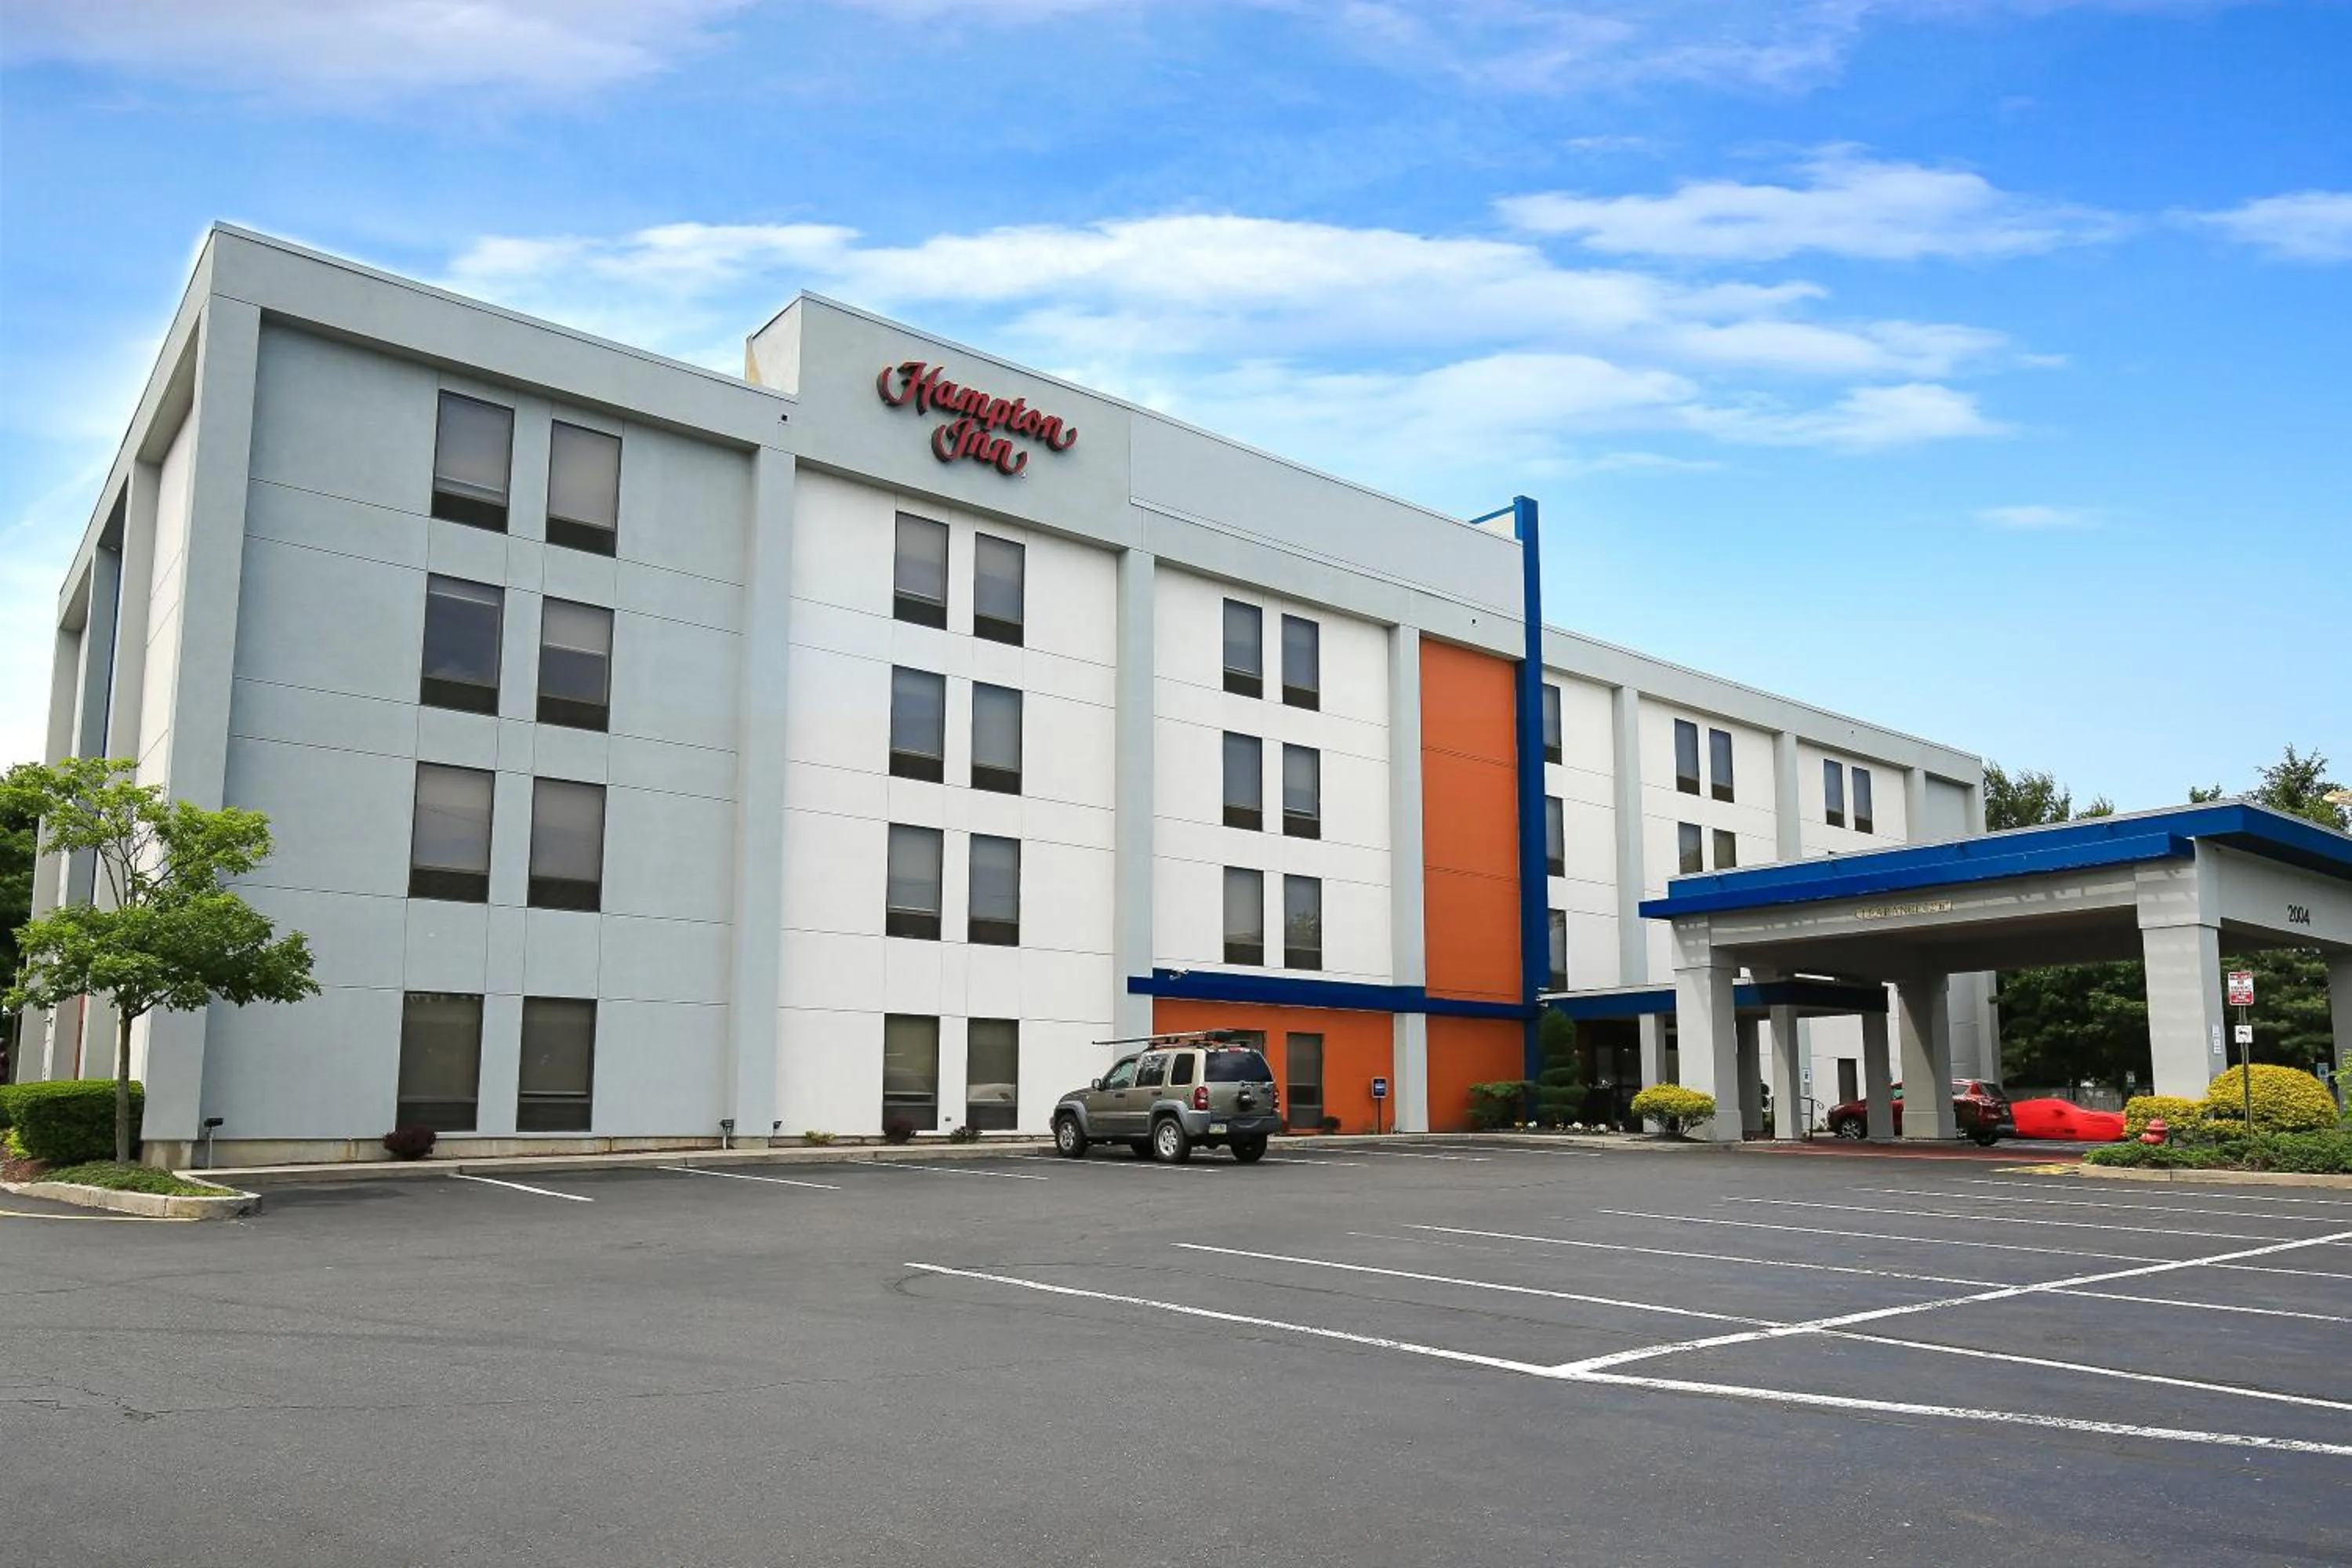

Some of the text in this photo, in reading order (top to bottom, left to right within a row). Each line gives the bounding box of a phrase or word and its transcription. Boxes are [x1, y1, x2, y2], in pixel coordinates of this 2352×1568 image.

[877, 361, 1078, 452] Hampton
[931, 417, 1029, 476] Inn
[2287, 904, 2310, 927] 2004
